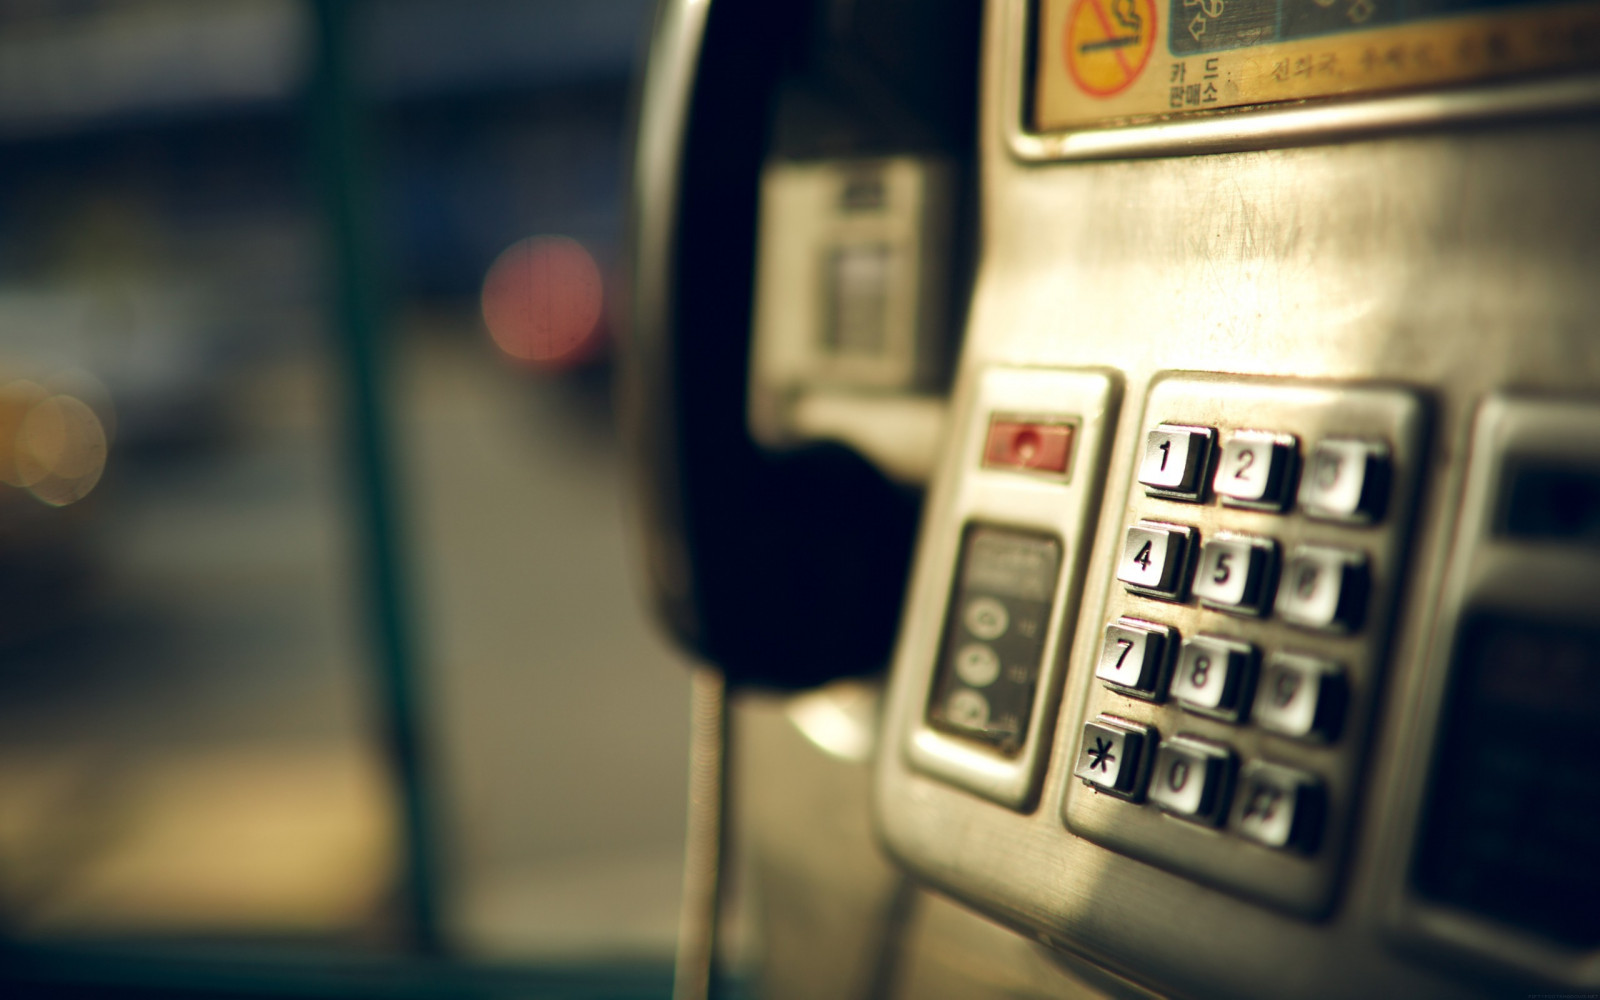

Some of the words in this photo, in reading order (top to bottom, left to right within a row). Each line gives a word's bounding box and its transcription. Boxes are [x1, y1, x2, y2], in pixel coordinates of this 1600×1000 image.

[1159, 439, 1171, 472] 1
[1233, 449, 1255, 481] 2
[1133, 539, 1152, 572] 4
[1213, 553, 1231, 585] 5
[1115, 638, 1135, 670] 7
[1191, 654, 1211, 689] 8
[1168, 759, 1190, 793] 0
